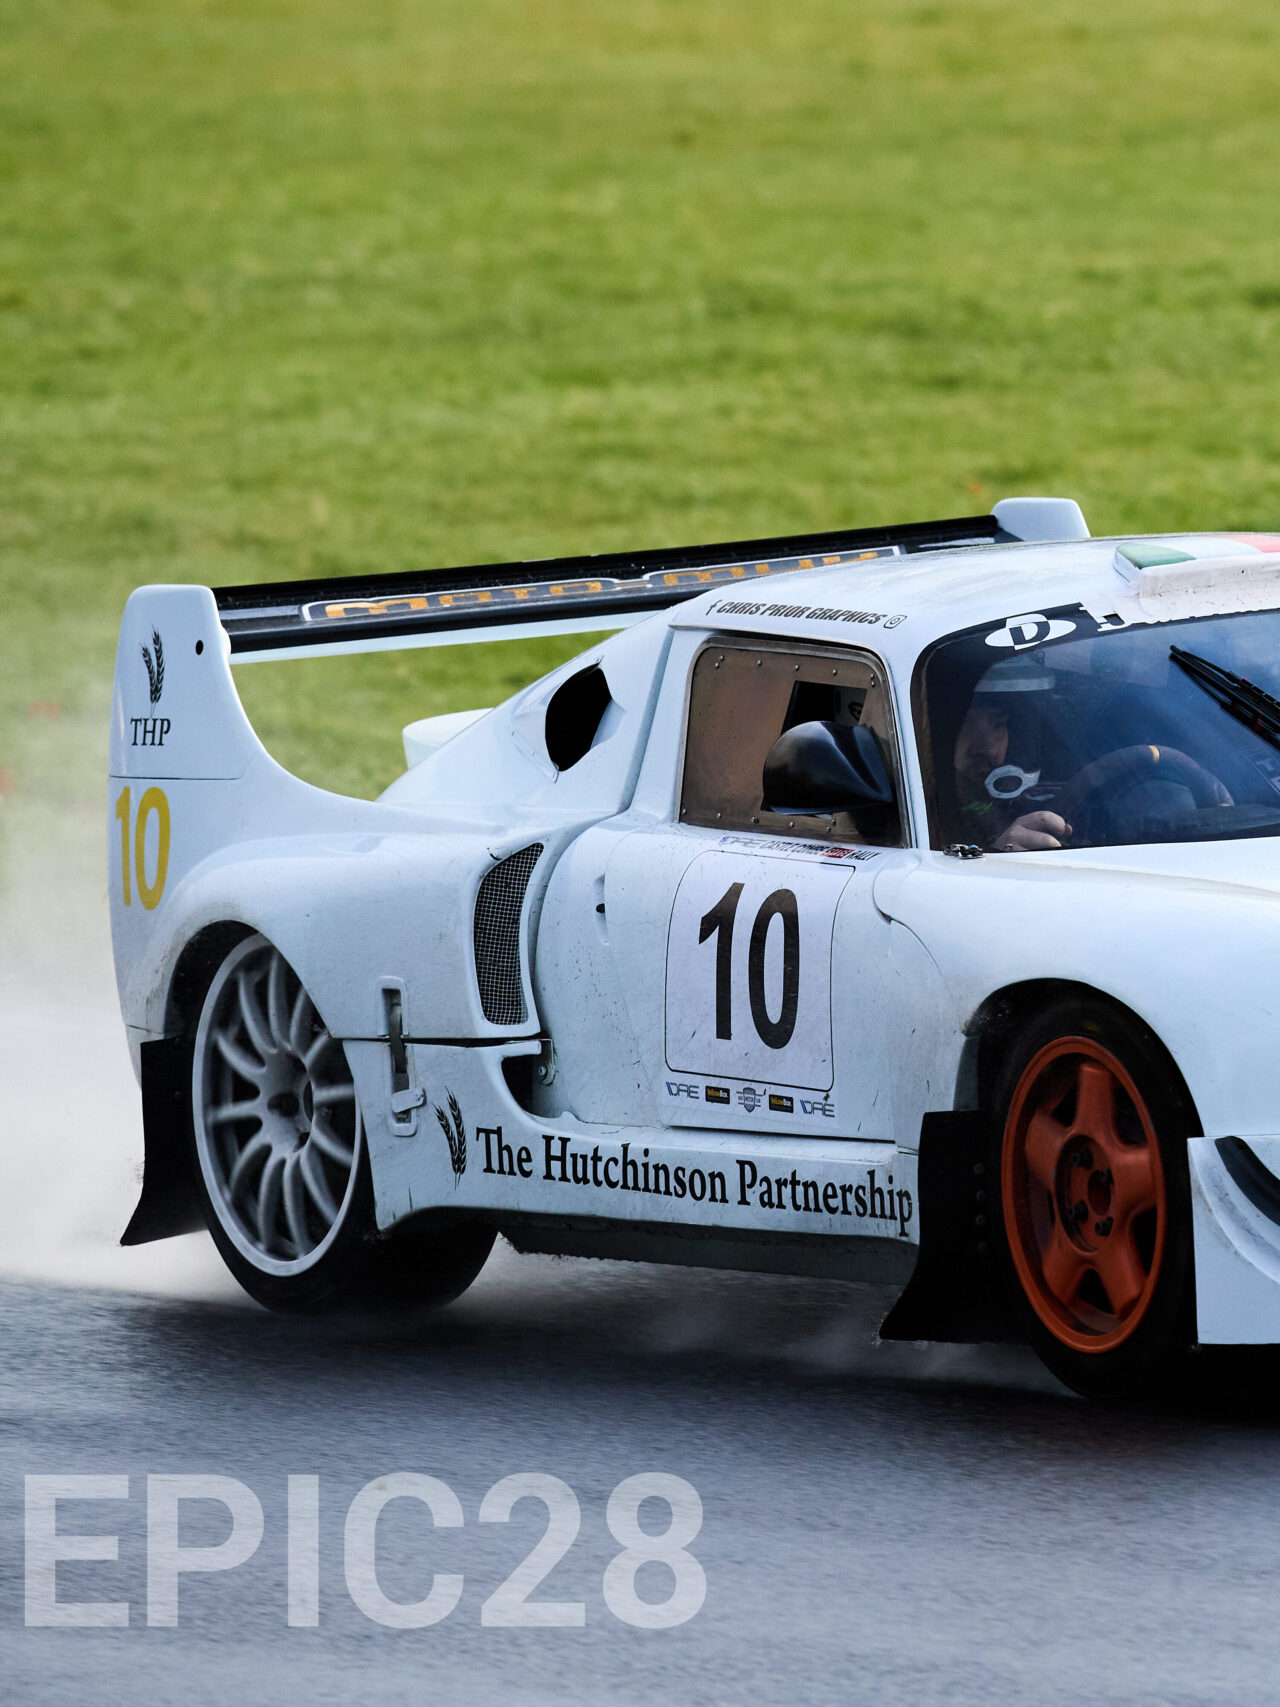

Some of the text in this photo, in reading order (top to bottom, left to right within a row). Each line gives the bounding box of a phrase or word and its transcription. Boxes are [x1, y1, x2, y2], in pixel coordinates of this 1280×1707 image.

[716, 601, 767, 616] CHRIS
[760, 603, 808, 619] PRIOR
[805, 607, 888, 625] GRAPHICS
[130, 717, 171, 746] THP
[115, 786, 171, 911] 10
[698, 881, 800, 1050] 10
[475, 1126, 914, 1237] The Hutchinson Partnership
